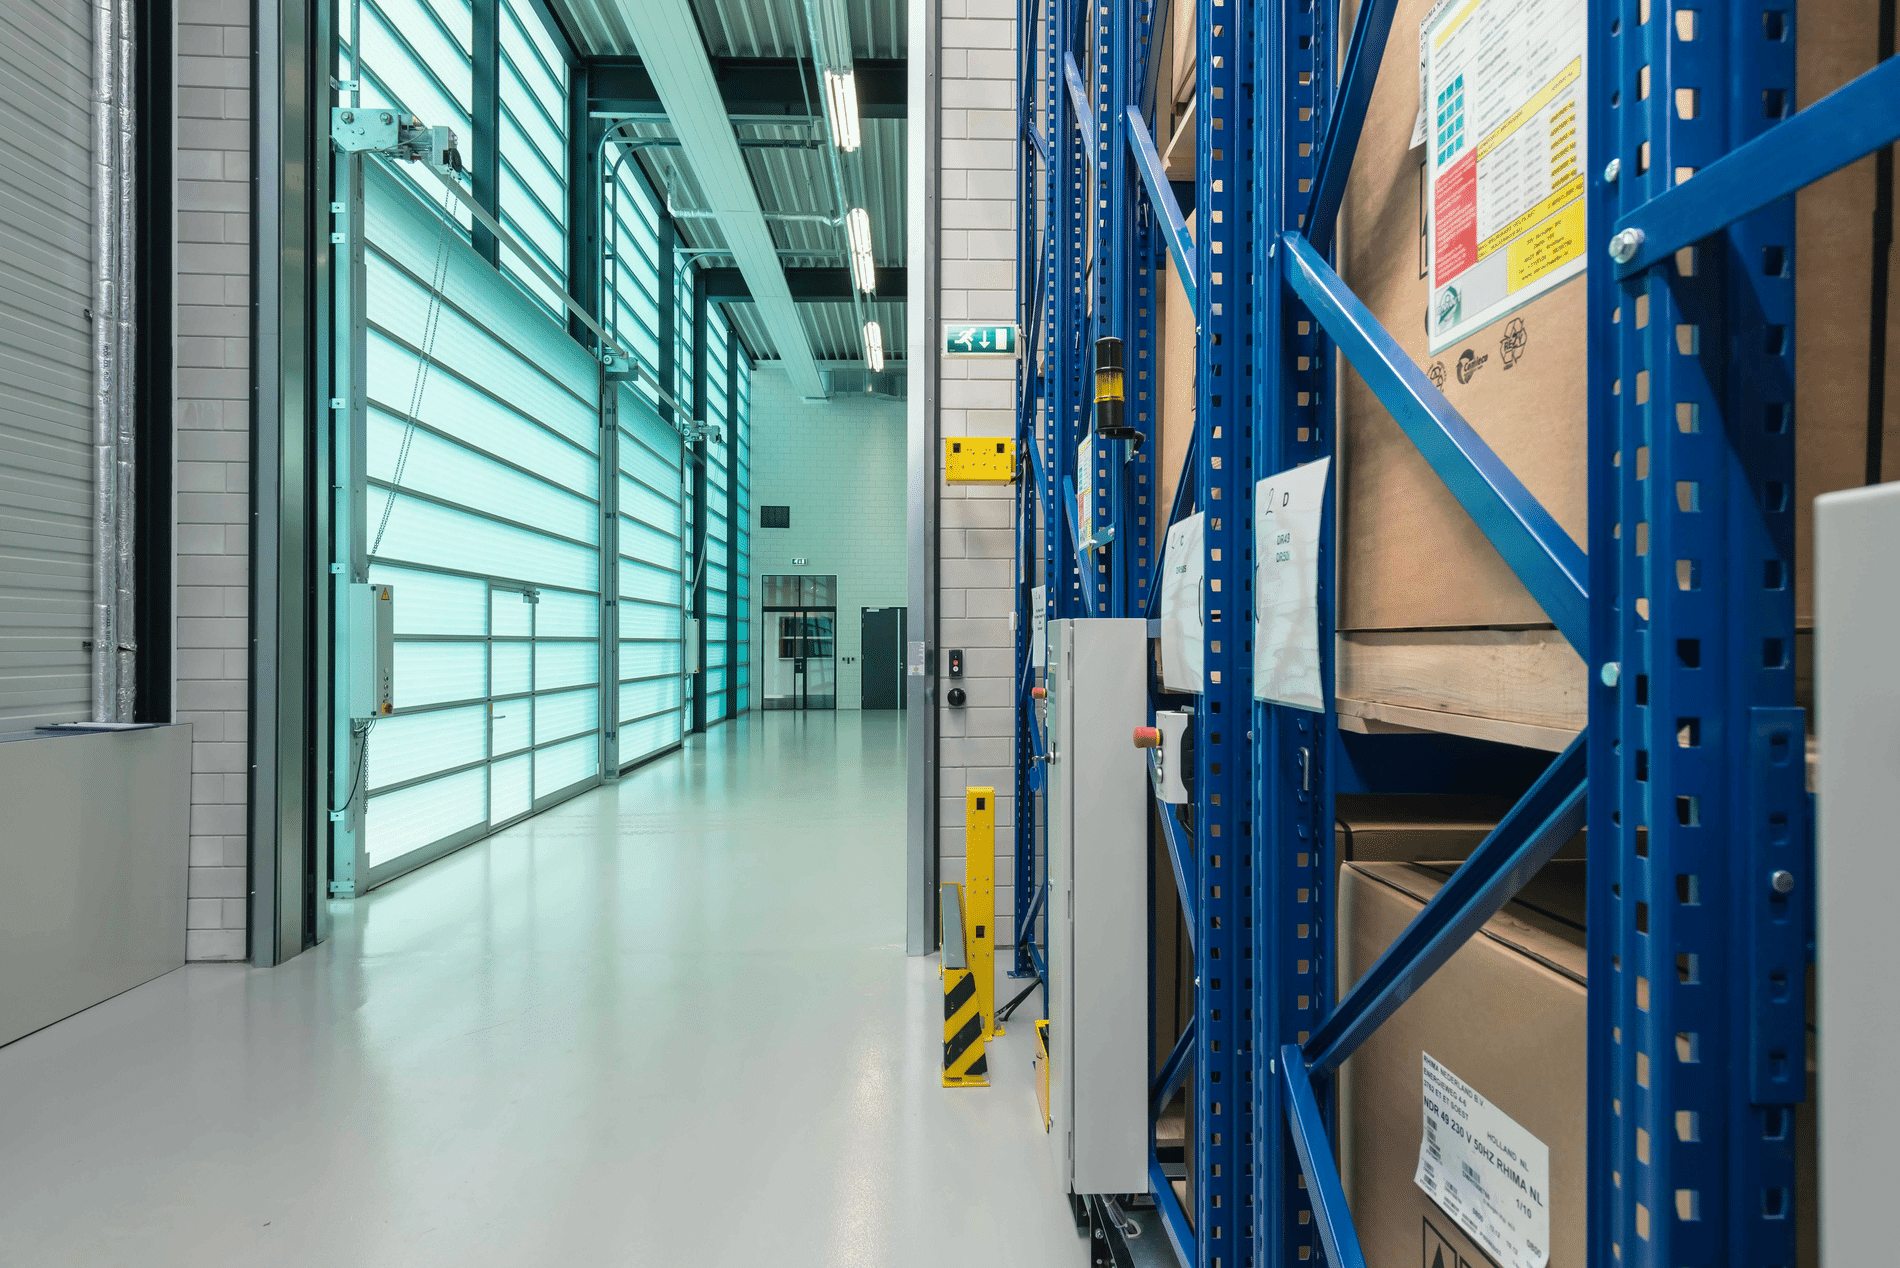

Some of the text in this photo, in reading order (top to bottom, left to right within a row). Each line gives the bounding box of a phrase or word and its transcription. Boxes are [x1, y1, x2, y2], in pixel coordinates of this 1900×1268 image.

[1282, 492, 1290, 507] D
[1423, 1055, 1439, 1072] RHIMA
[1440, 1068, 1473, 1098] NEDERLAND
[1423, 1095, 1439, 1117] NDR
[1440, 1111, 1450, 1125] 49
[1451, 1119, 1464, 1138] 230
[1466, 1131, 1472, 1144] V
[1474, 1138, 1495, 1165] 50HZ
[1497, 1158, 1528, 1193] RHIMA
[1529, 1186, 1543, 1207] NL
[1487, 1131, 1529, 1172] HOLLAND NL
[1516, 1198, 1532, 1219] 1/10
